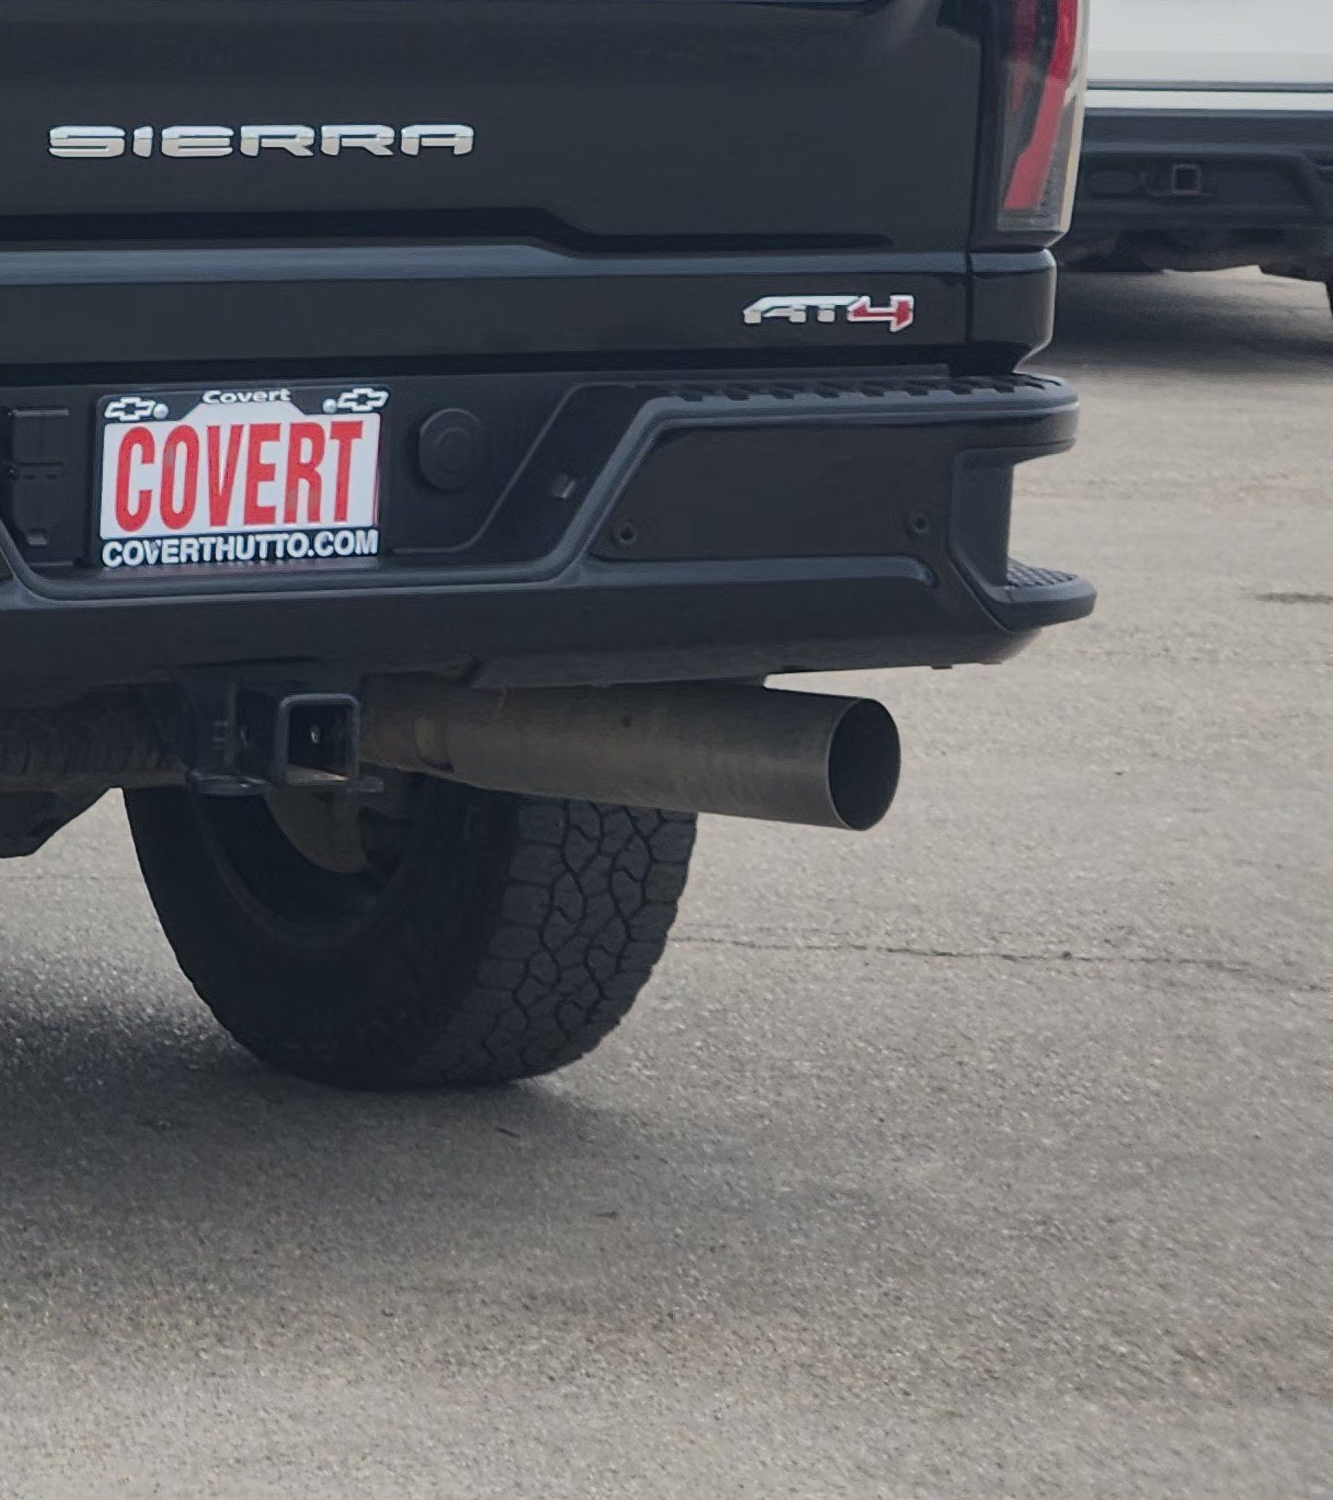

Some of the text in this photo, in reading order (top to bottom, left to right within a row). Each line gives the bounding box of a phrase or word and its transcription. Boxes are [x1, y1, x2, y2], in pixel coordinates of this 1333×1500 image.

[48, 124, 474, 158] SIERRA
[743, 295, 915, 333] AT4
[201, 387, 292, 404] Covert
[114, 420, 364, 533] COVERT
[101, 529, 380, 569] COVERTHUTTO.COM
